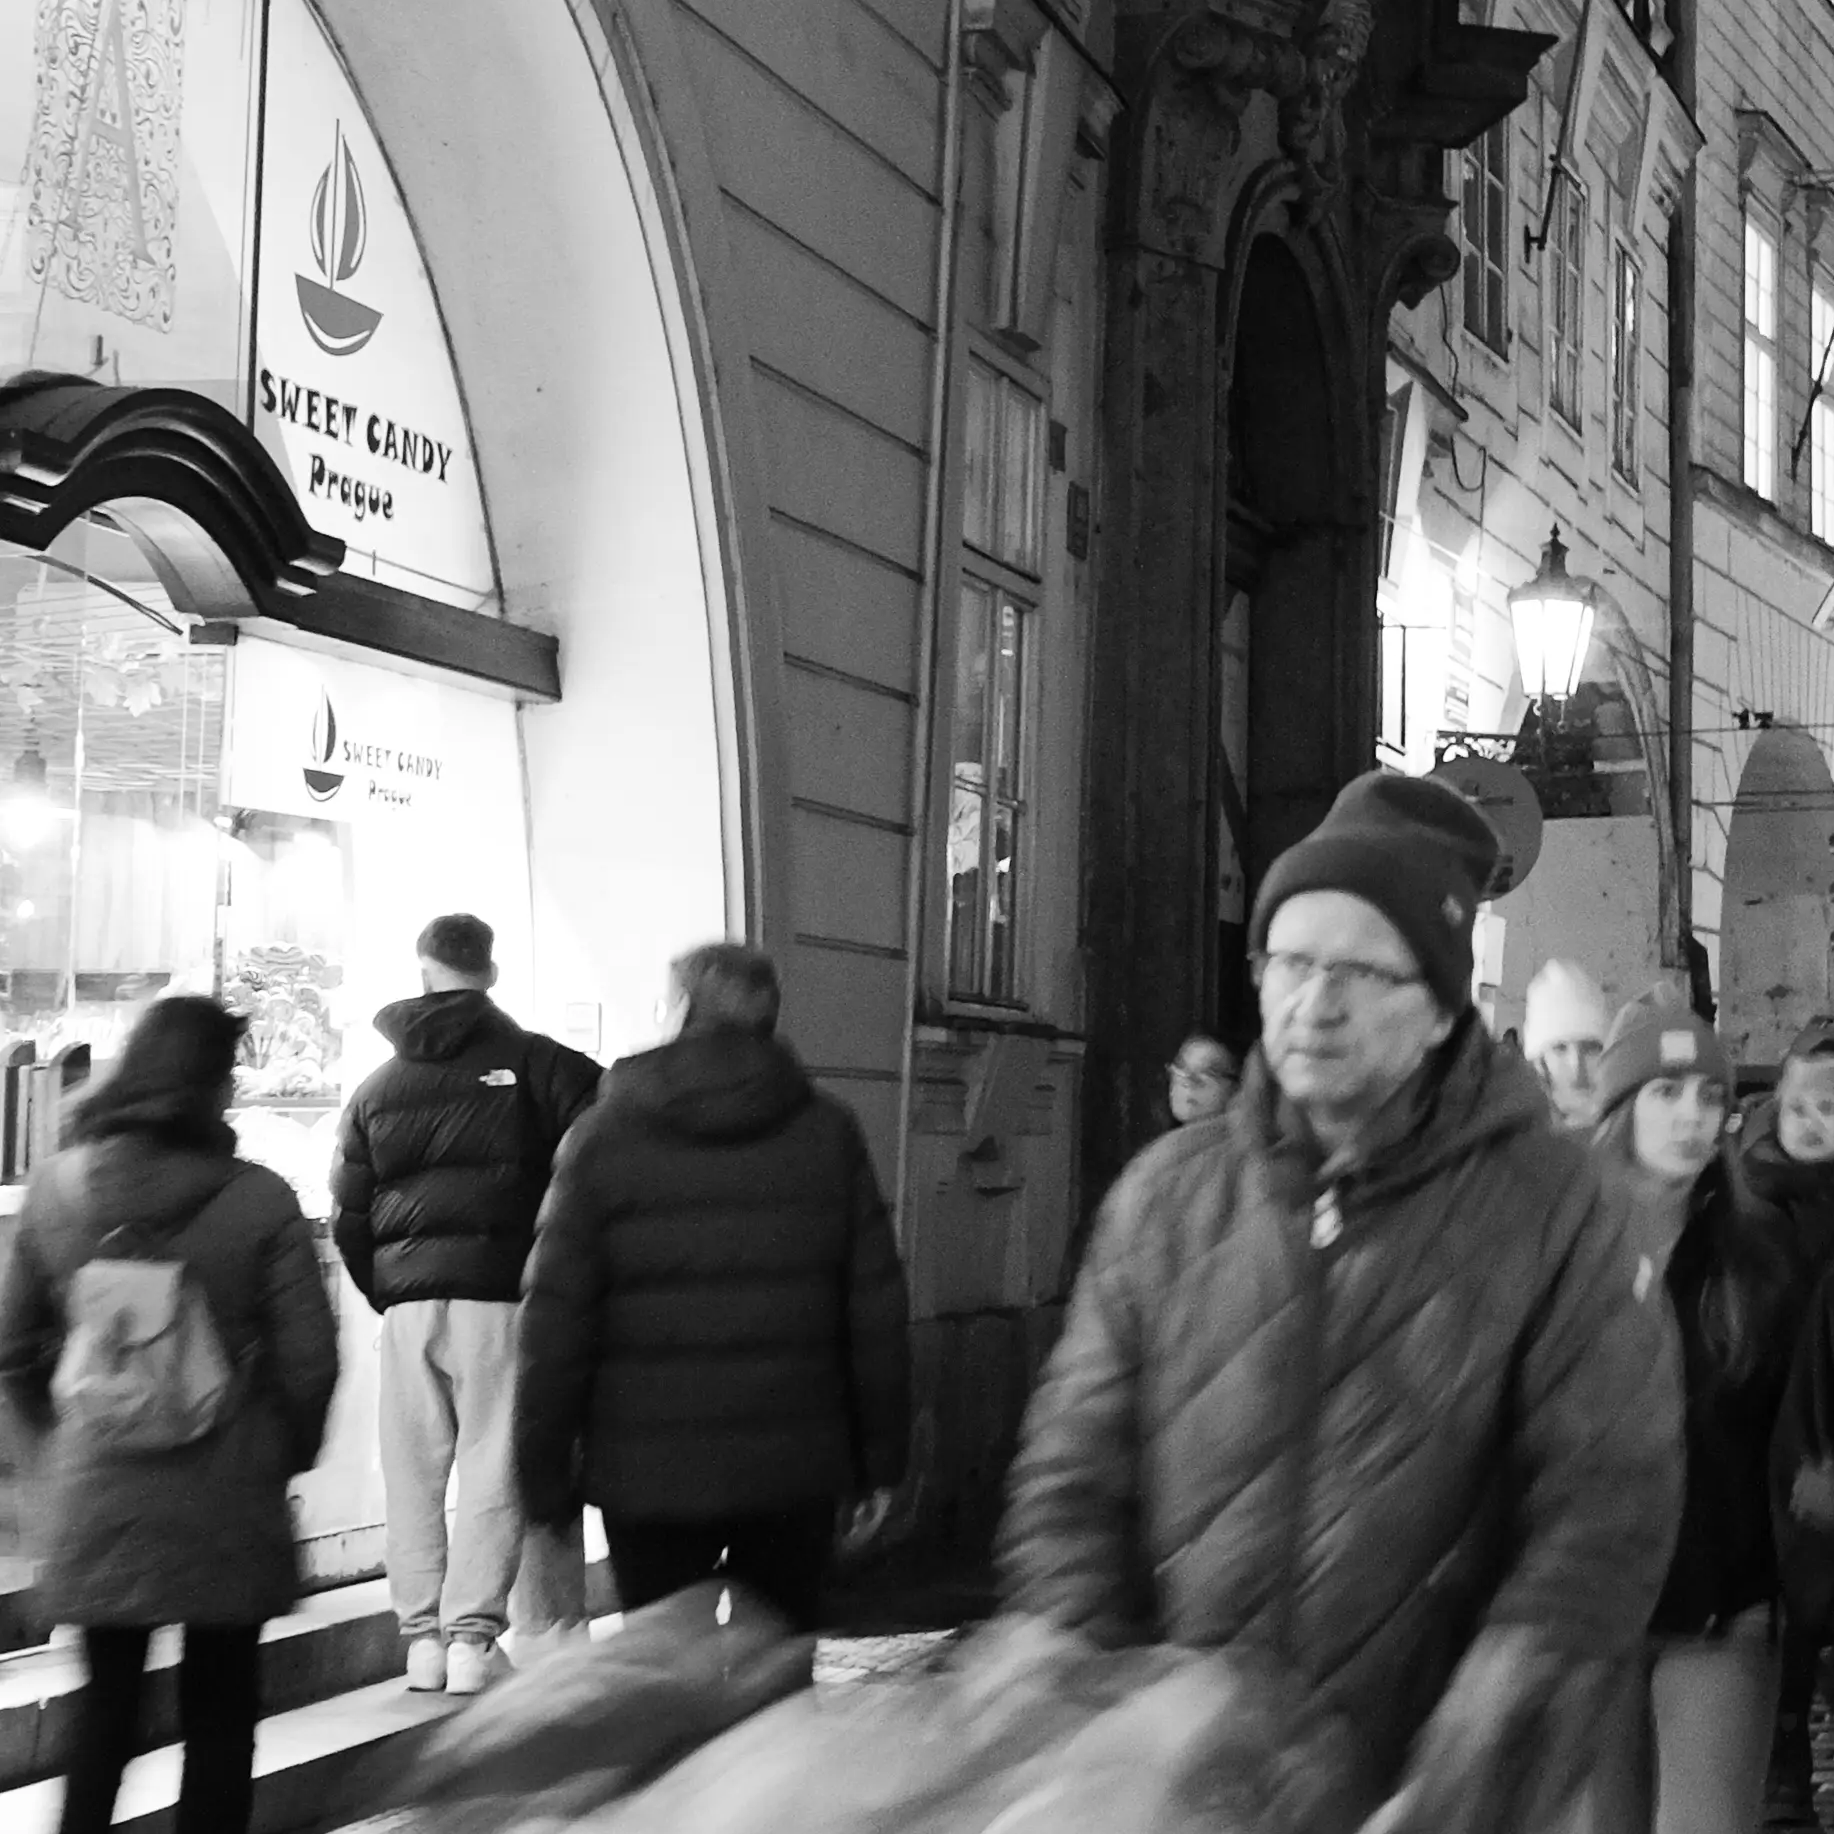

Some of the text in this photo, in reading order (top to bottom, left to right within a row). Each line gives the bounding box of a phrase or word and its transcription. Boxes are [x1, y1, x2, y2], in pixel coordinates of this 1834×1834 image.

[260, 368, 452, 485] SWEET CANDY
[308, 452, 394, 522] Prague
[343, 739, 443, 780] SWEET CANDY
